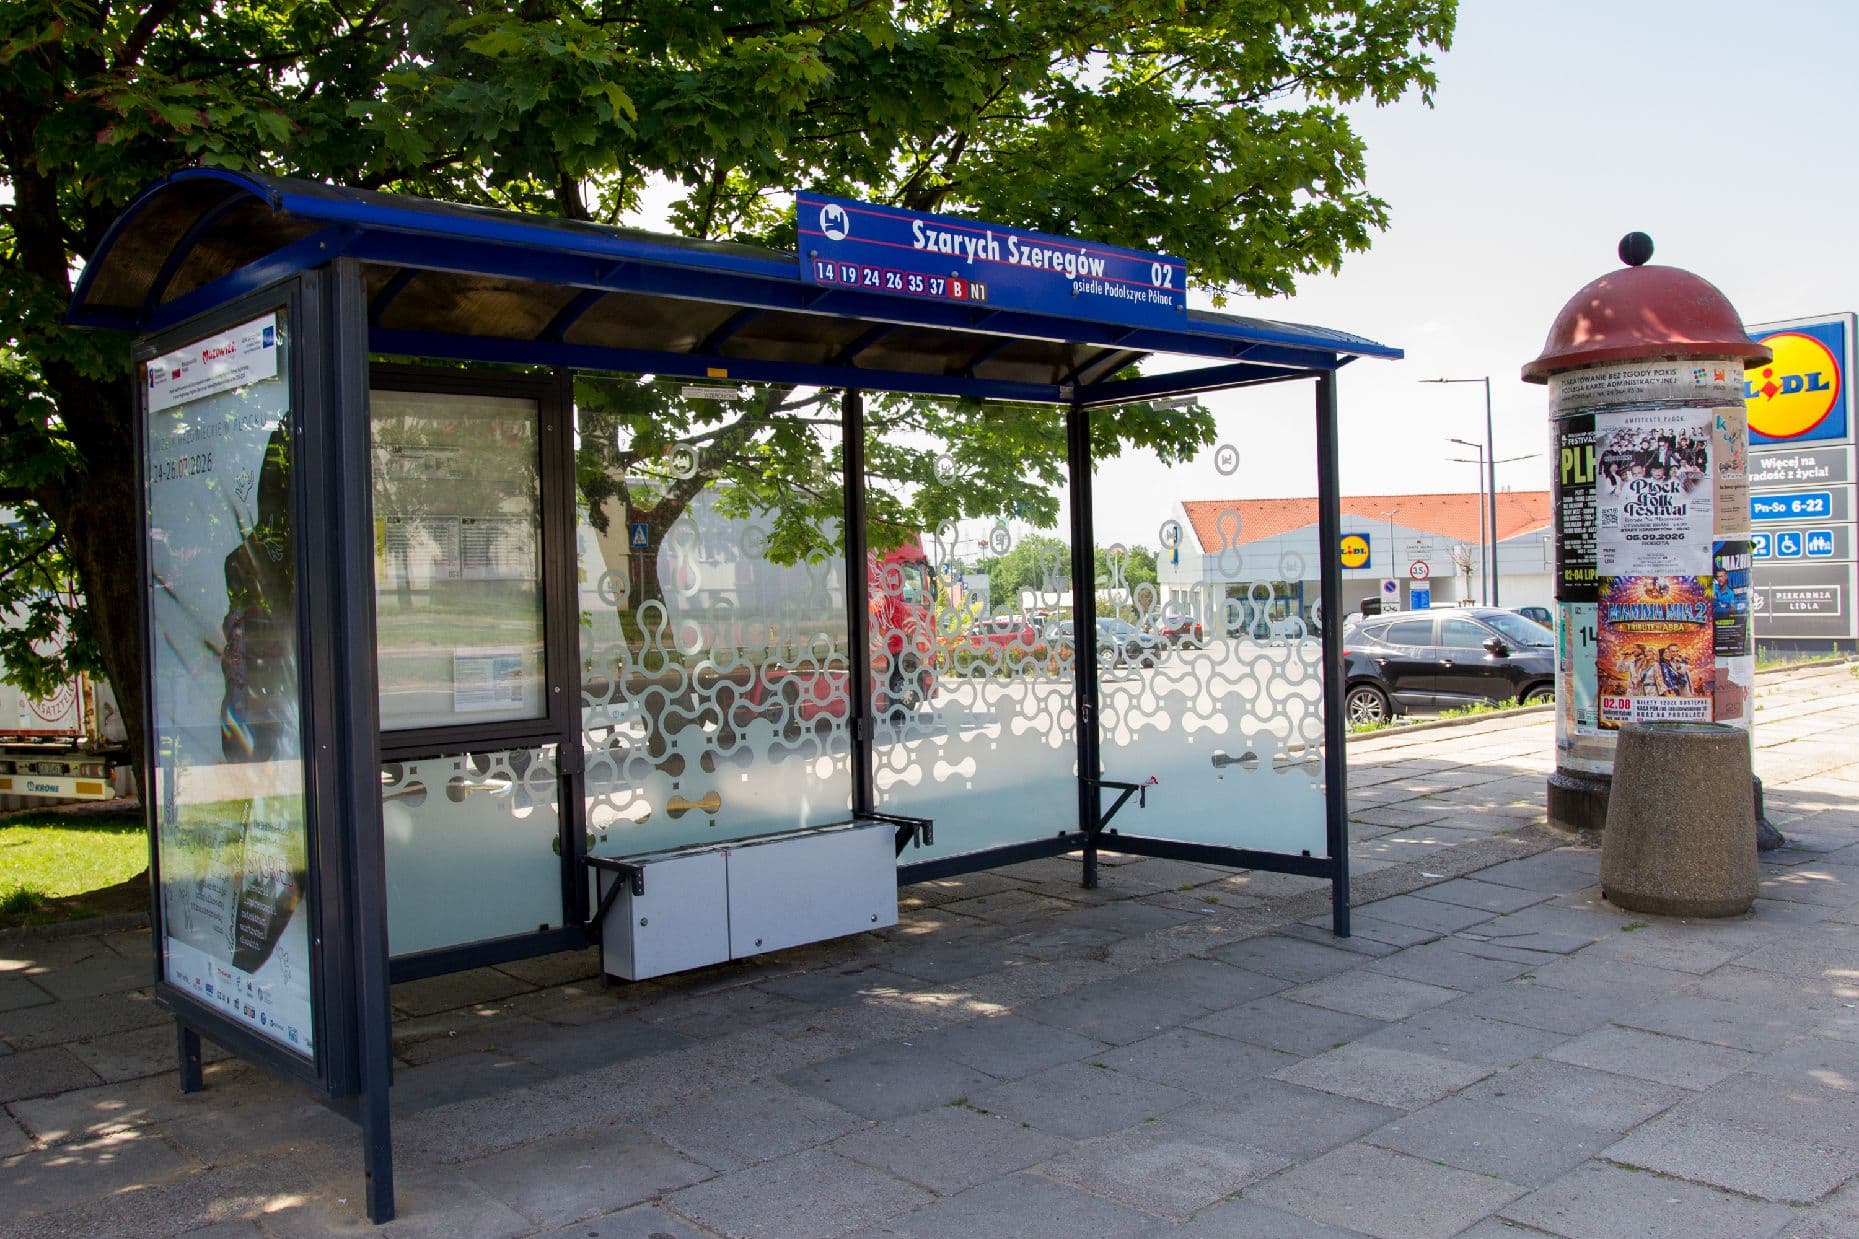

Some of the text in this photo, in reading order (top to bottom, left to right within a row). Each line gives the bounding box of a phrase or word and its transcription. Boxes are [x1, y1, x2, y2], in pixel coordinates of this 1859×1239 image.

[913, 219, 1105, 279] Szarych Szeregów
[817, 262, 986, 300] 14 19 24 26 35 37 B N1
[1151, 262, 1172, 288] 02
[1073, 279, 1173, 306] osiedle Podolszyce Północ
[1760, 457, 1816, 469] Więcej na
[1749, 466, 1829, 482] radość z życia!
[1753, 499, 1823, 513] Pn-So 6-22
[1776, 592, 1831, 600] PIEKARNIA
[1608, 601, 1709, 624] MAMMA MIA 2
[1789, 602, 1819, 610] LIDLA
[1603, 698, 1631, 710] 02.08
[35, 783, 60, 793] KRONE
